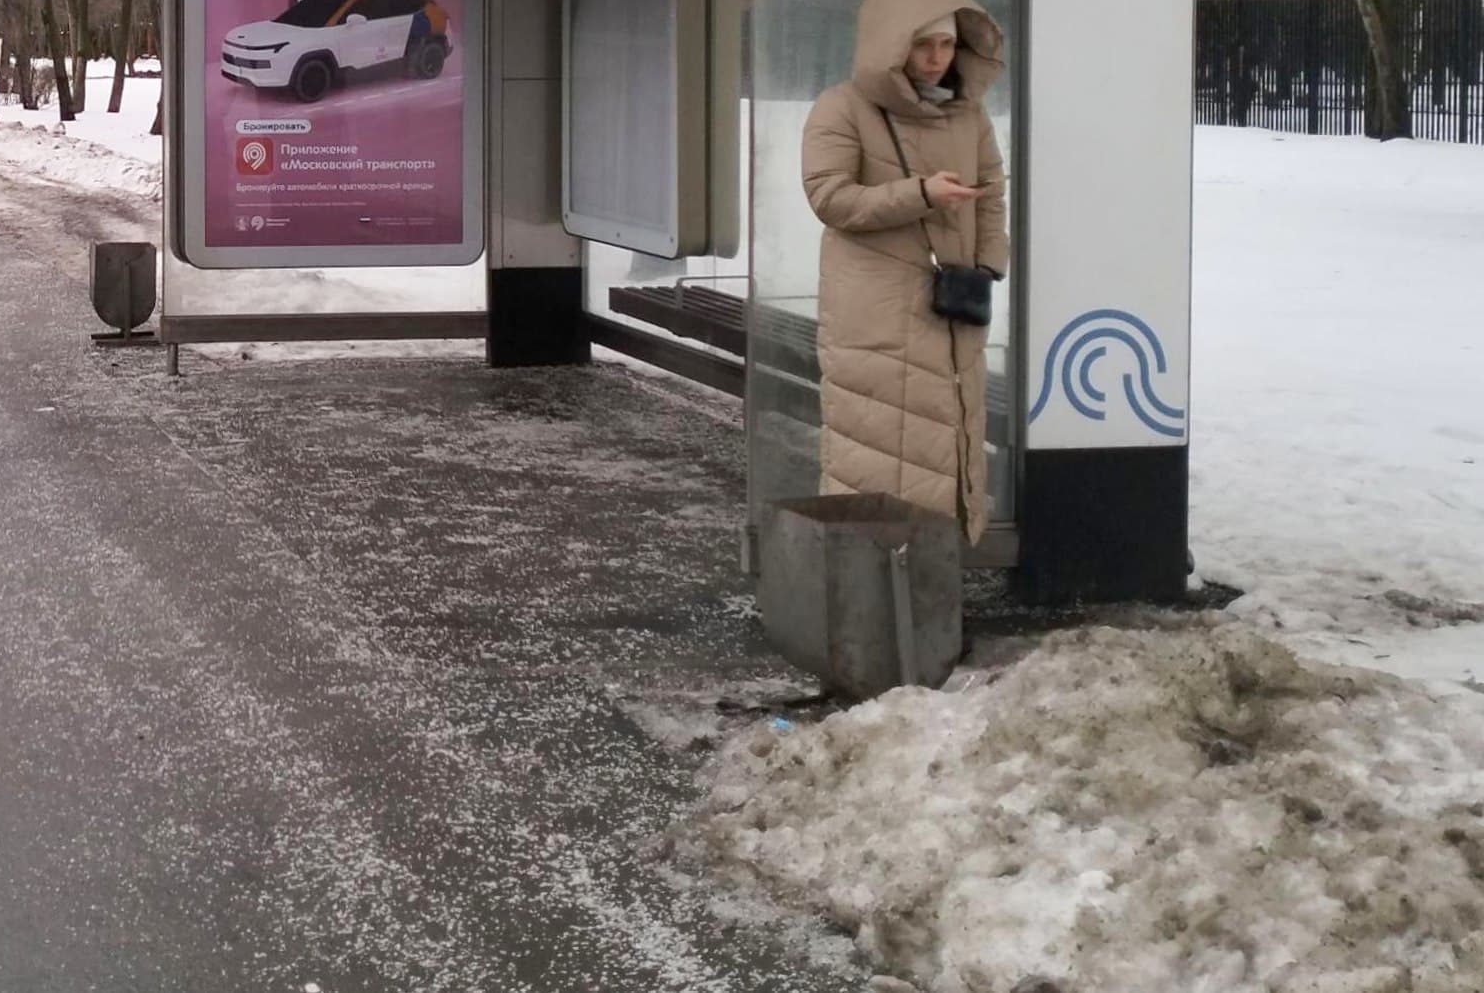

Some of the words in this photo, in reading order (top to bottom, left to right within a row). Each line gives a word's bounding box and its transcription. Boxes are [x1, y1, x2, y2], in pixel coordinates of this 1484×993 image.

[243, 122, 306, 132] Бронировать
[280, 144, 359, 157] Приложение
[280, 158, 364, 171] «Московский
[366, 160, 436, 172] транспорт»
